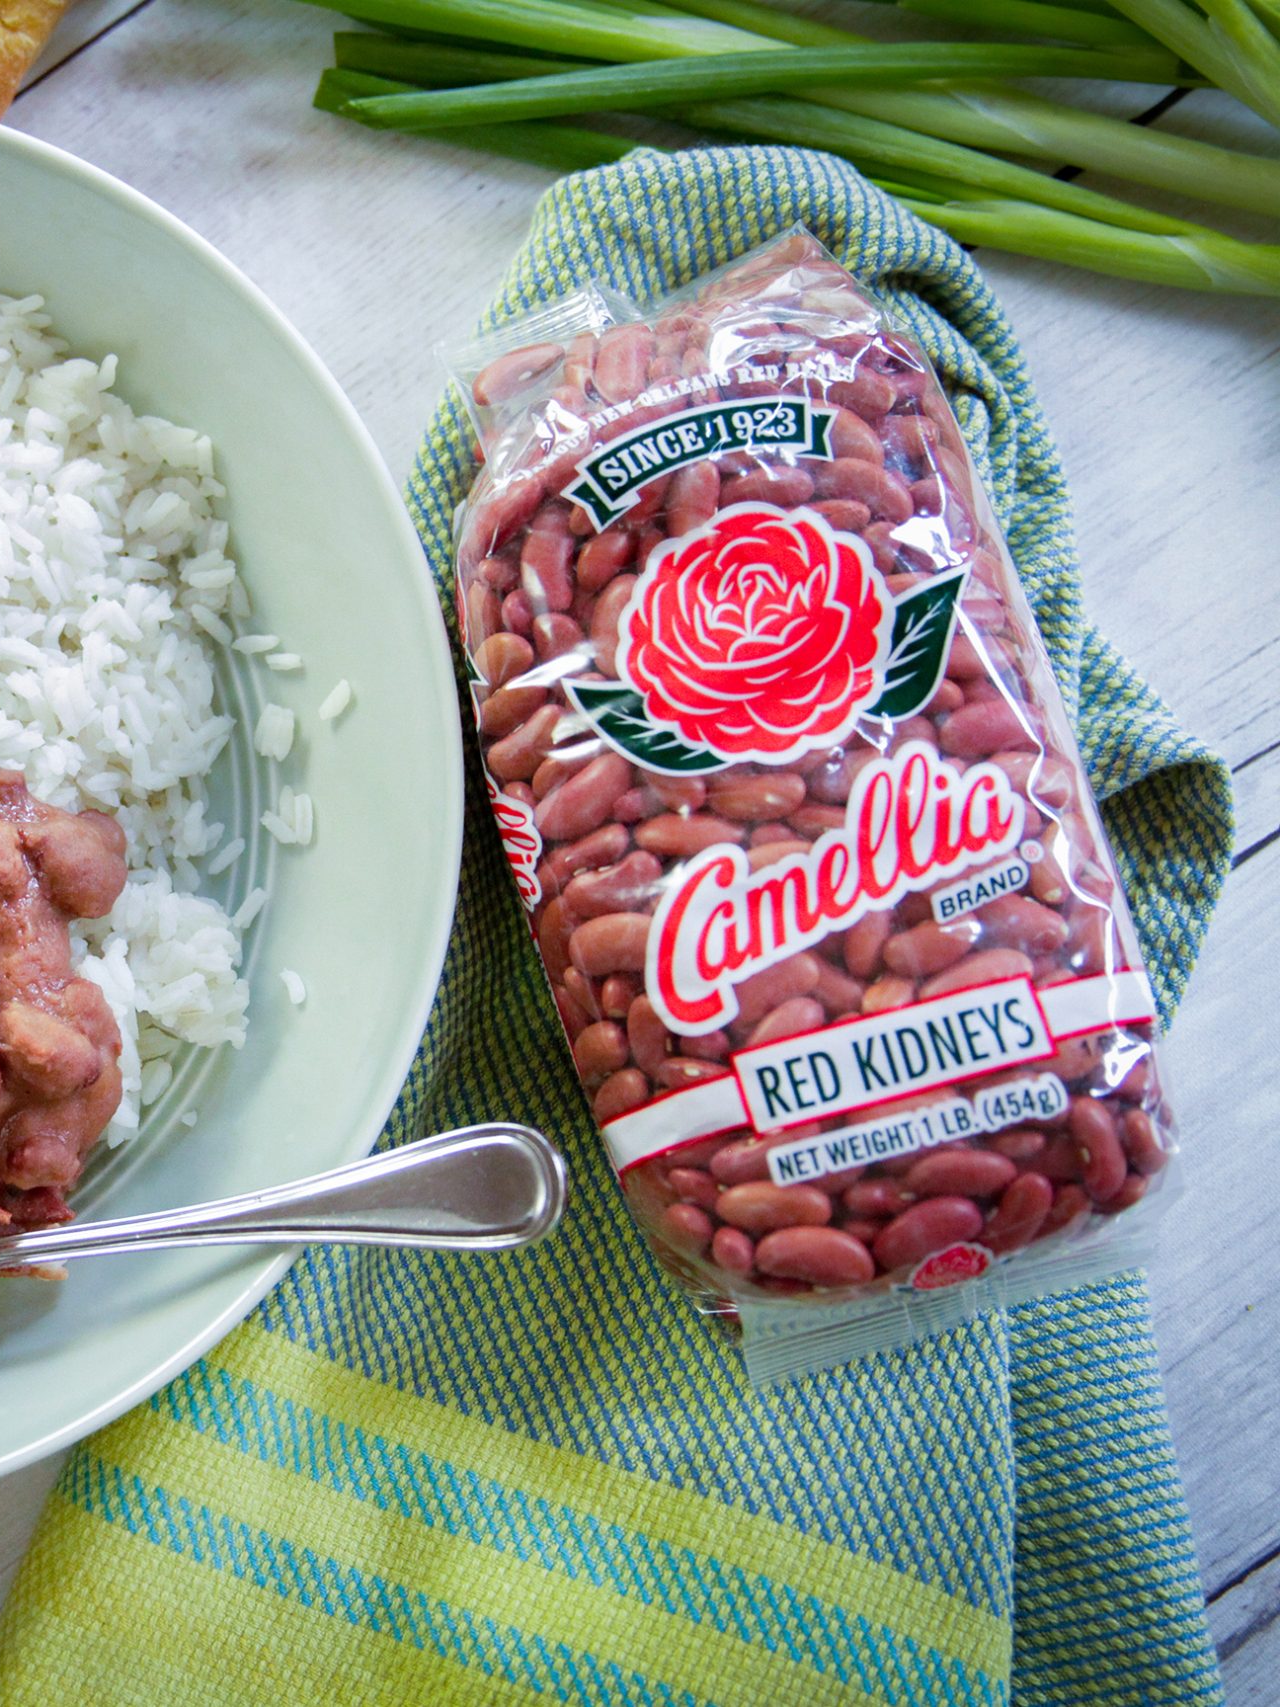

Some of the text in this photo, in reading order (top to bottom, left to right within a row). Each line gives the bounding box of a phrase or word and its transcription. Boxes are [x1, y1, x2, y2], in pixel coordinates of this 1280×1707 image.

[588, 399, 634, 429] NEW
[637, 371, 731, 407] ORLEANS
[735, 362, 779, 384] RED
[598, 407, 797, 490] SINCE 1923
[657, 753, 1014, 1023] Camellia
[940, 866, 1024, 917] BRAND
[756, 998, 1034, 1118] RED KIDNEYS
[776, 1082, 1062, 1181] NET WEIGHT 1 LB. (454g)
